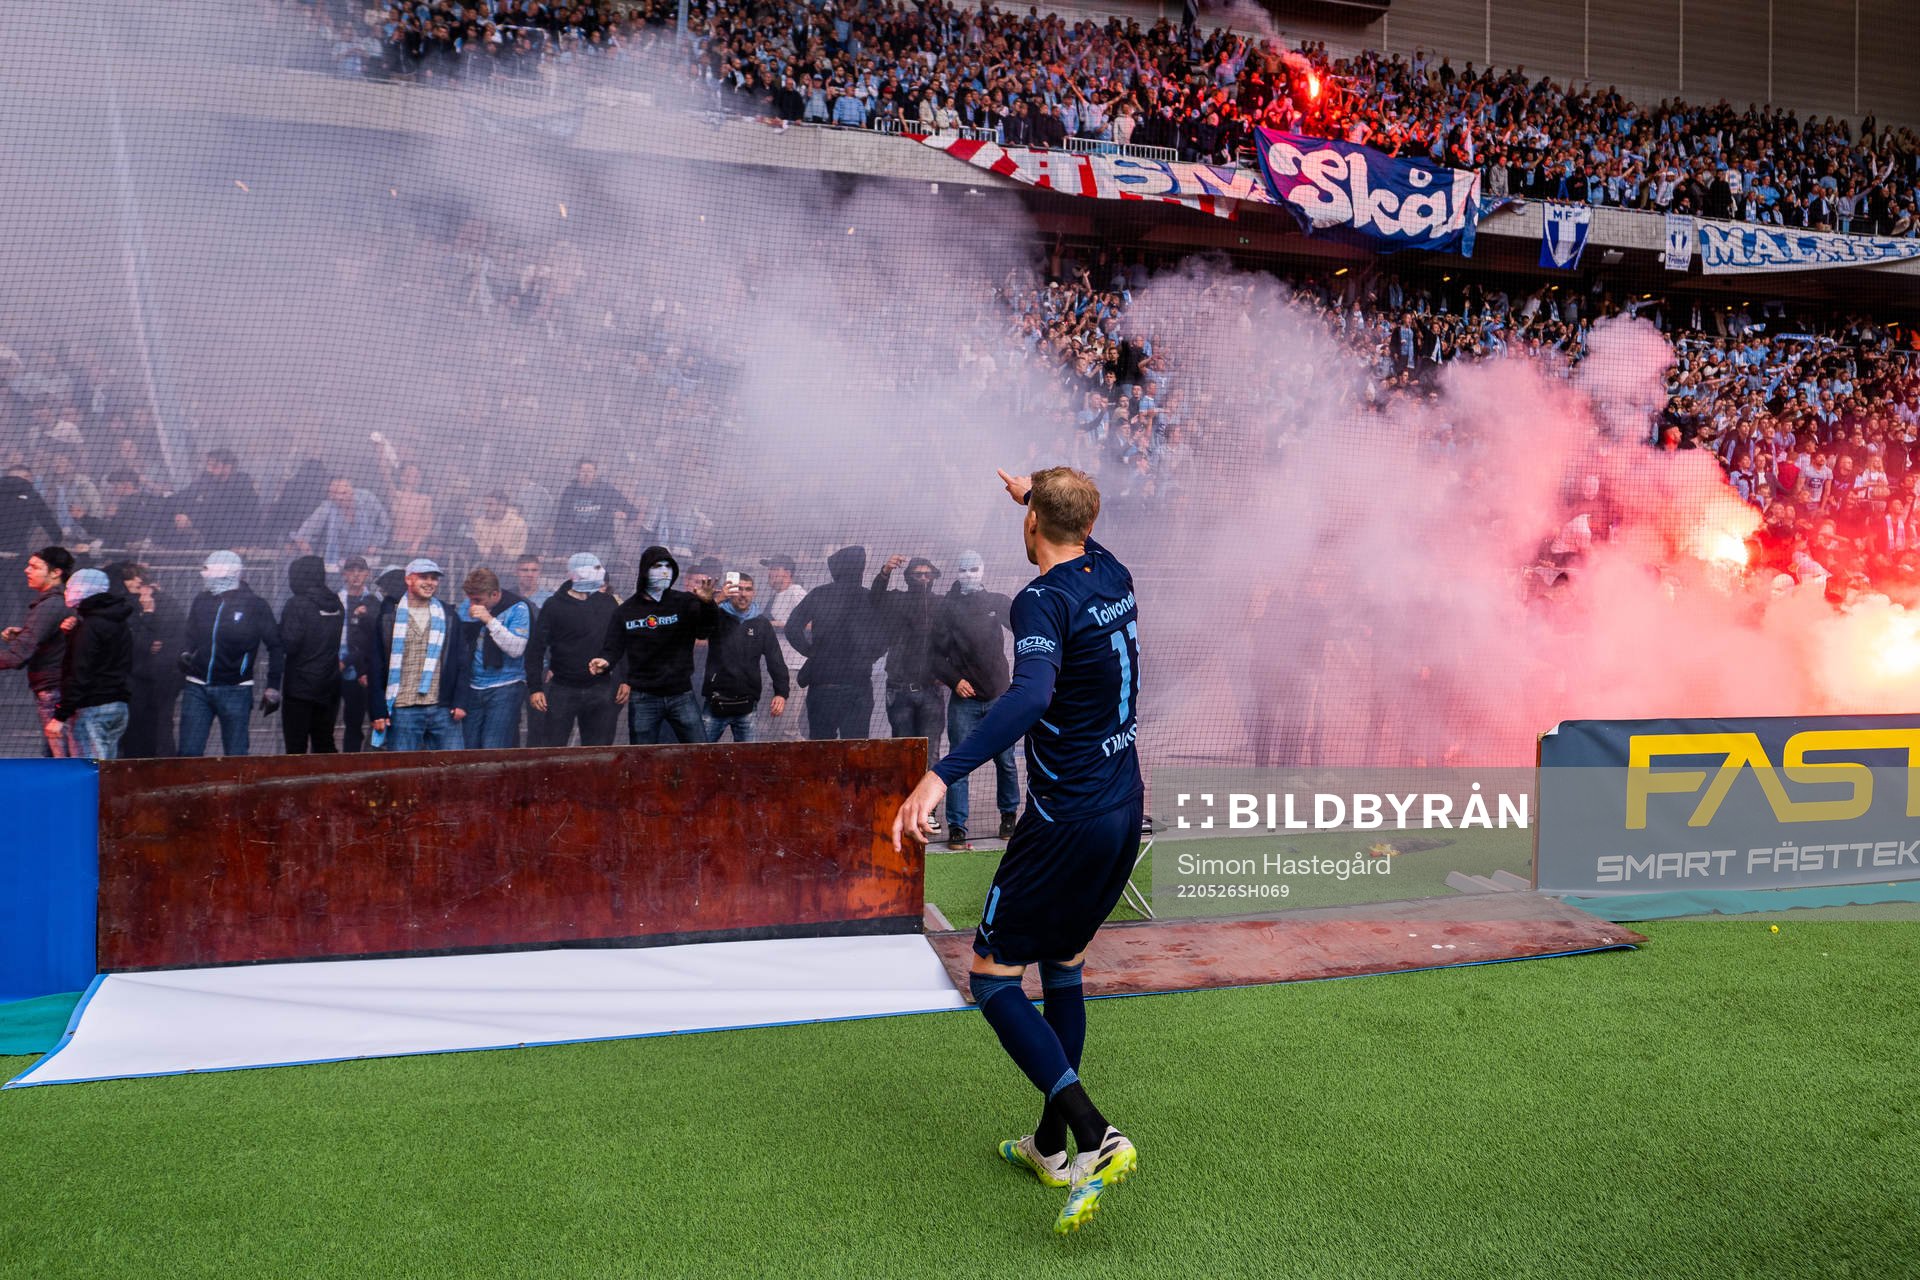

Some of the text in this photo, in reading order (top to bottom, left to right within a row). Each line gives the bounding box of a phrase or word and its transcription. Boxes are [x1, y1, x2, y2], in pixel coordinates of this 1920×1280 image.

[1268, 141, 1481, 238] Skål
[1088, 591, 1136, 627] Toivone
[1016, 635, 1056, 650] TICTAC
[1596, 841, 1920, 883] SMART FÄSTTEK
